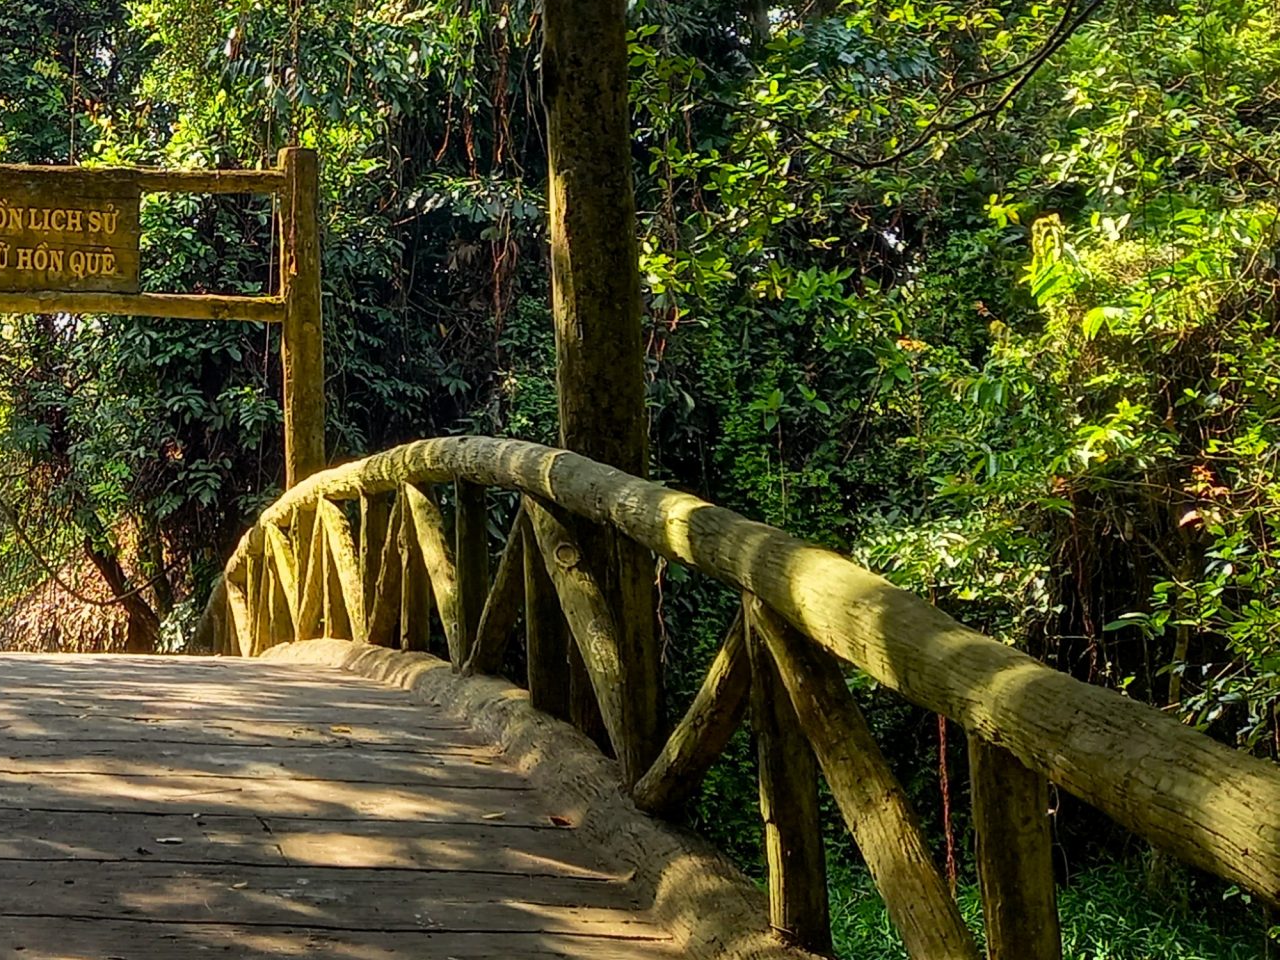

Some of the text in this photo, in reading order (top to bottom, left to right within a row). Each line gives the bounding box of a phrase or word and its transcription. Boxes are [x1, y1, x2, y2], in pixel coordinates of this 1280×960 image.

[28, 207, 83, 236] LỊCH
[87, 203, 120, 235] SỬ
[15, 241, 64, 272] HỒN
[69, 246, 116, 280] QUÊ
